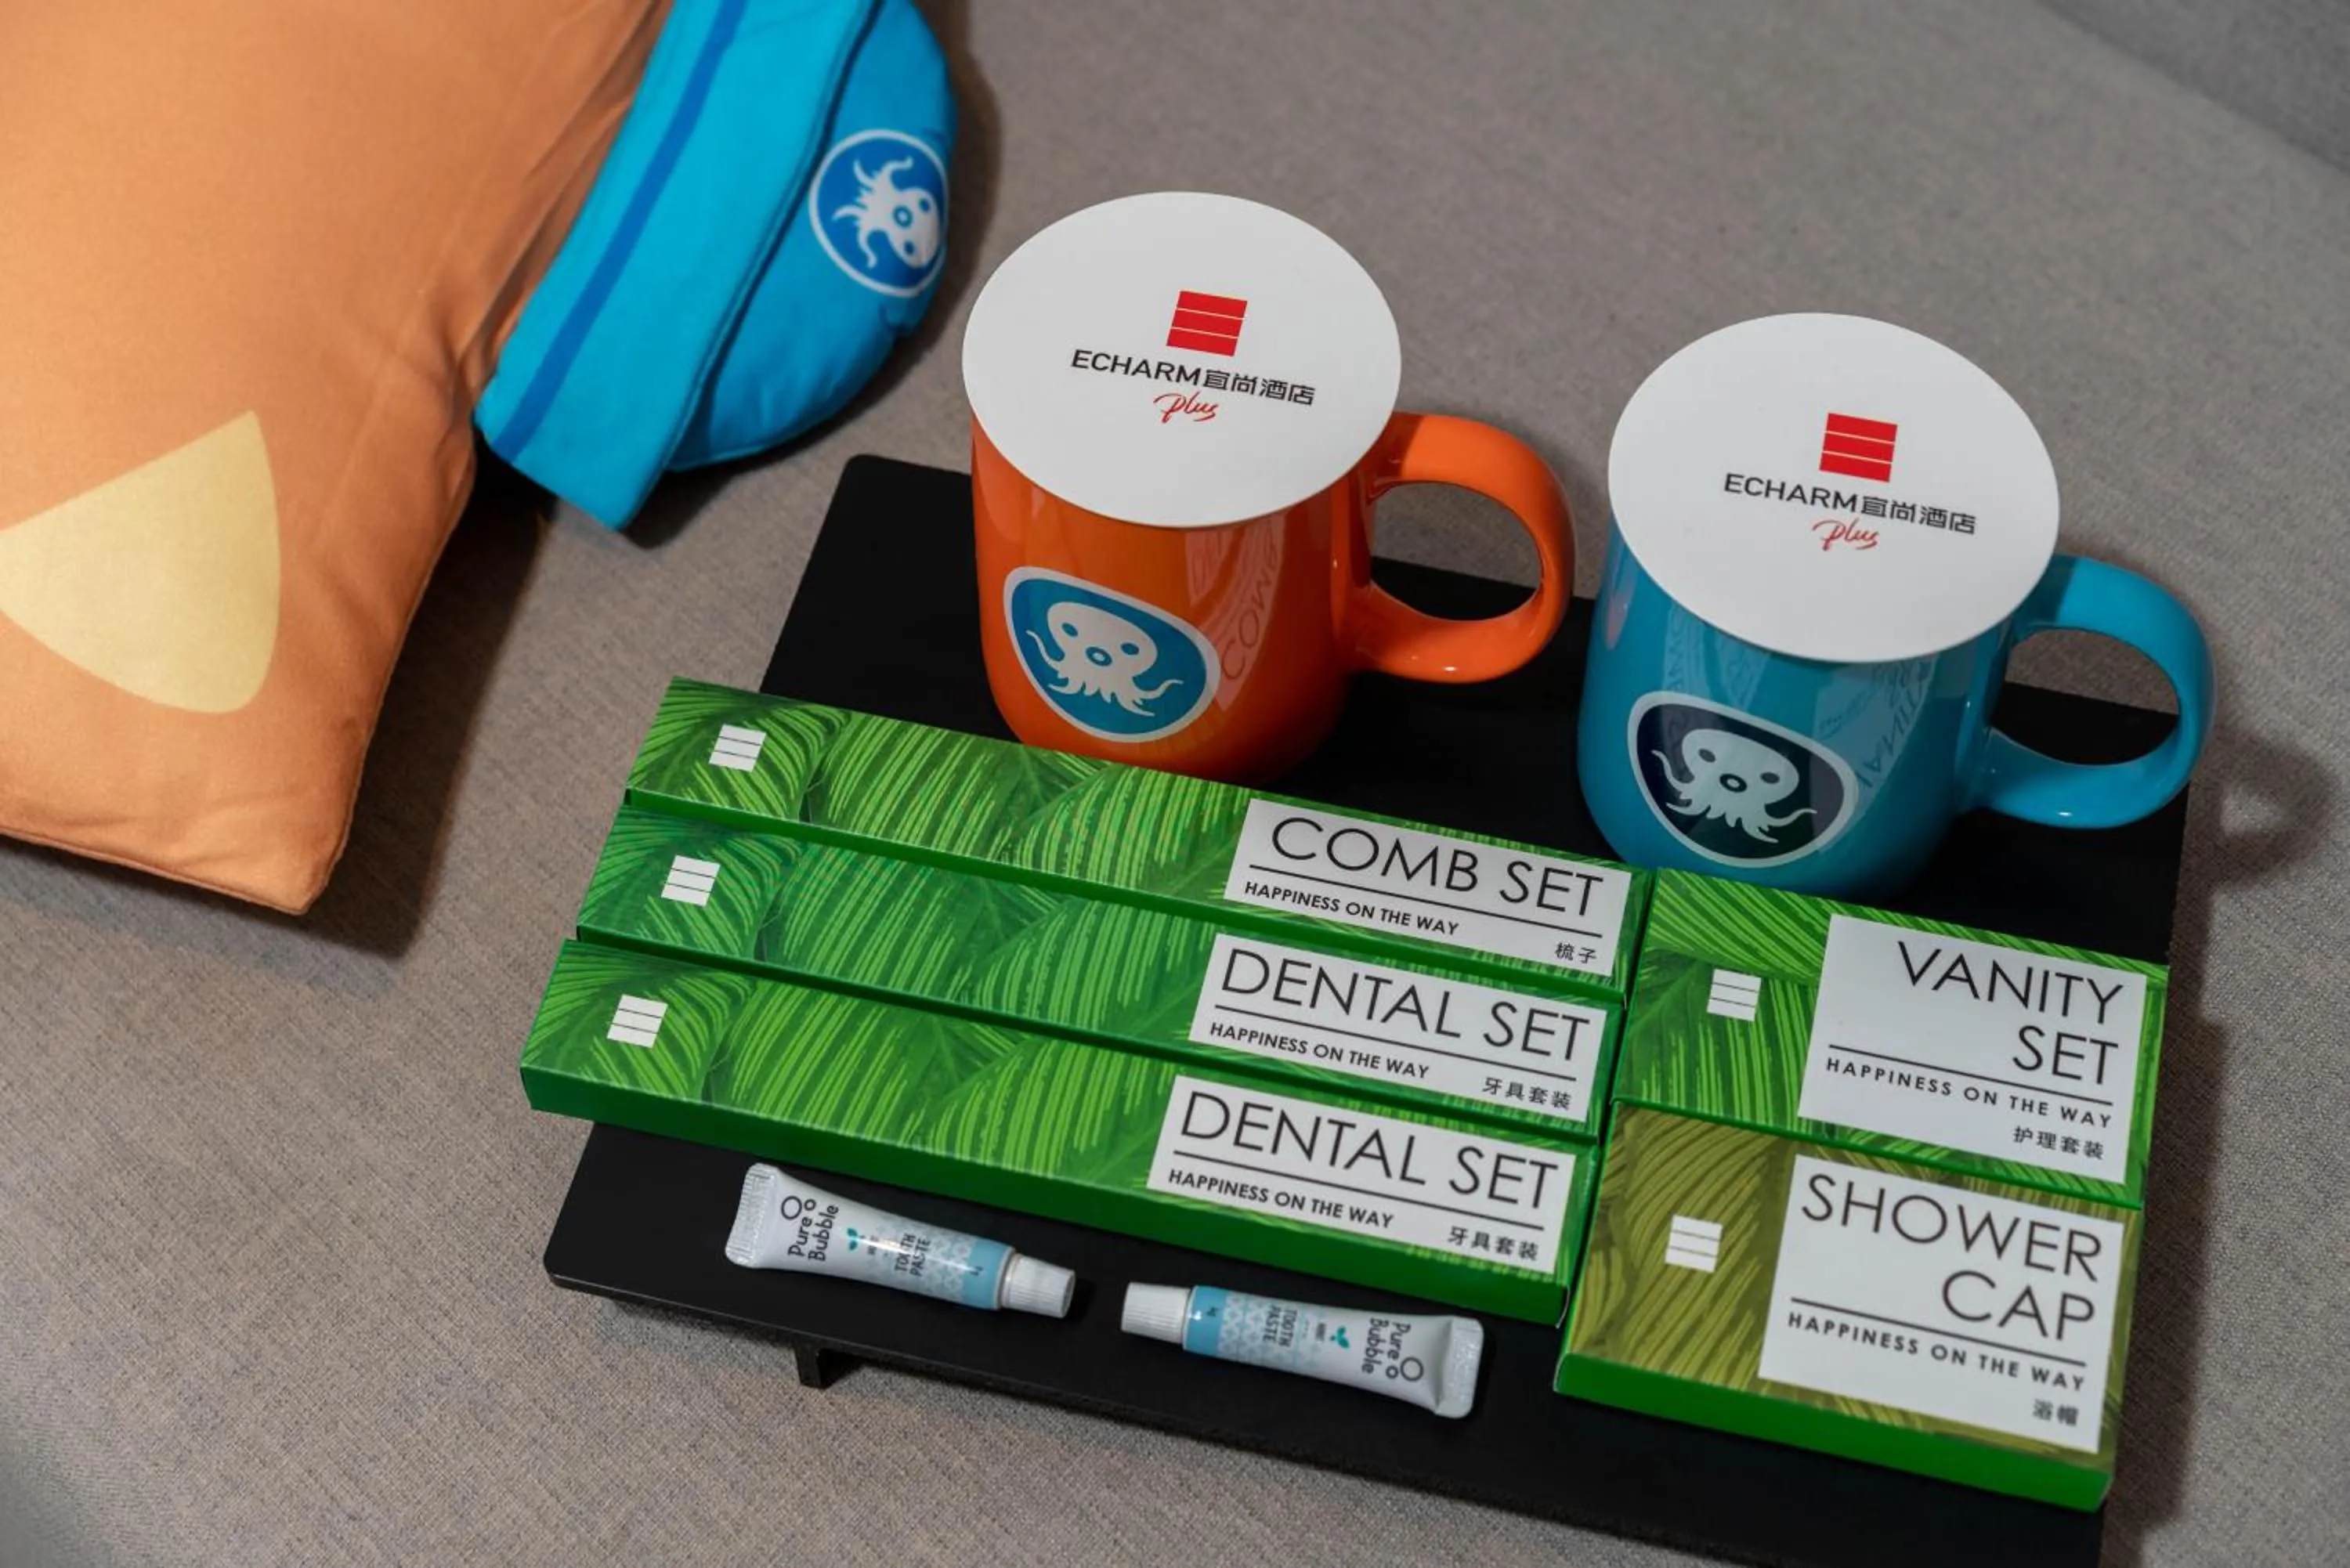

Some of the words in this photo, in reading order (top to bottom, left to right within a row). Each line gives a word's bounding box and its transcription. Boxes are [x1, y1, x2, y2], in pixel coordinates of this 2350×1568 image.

[1071, 349, 1202, 386] ECHARM
[1723, 472, 1857, 513] ECHARM
[1271, 817, 1479, 892] COMB
[1499, 860, 1604, 917] SET
[1244, 880, 1340, 912] HAPPINESS
[1345, 901, 1376, 920] ON
[1380, 908, 1412, 927] THE
[1416, 915, 1459, 936] WAY
[1554, 941, 1598, 964] 梳子
[1221, 948, 1462, 1039] DENTAL
[1483, 1000, 1590, 1061] SET
[1897, 940, 2124, 1024] VANITY
[1209, 1021, 1308, 1054] HAPPINESS
[1313, 1042, 1344, 1062] ON
[1349, 1050, 1380, 1070] THE
[1386, 1058, 1430, 1079] WAY
[2012, 1024, 2119, 1086] SET
[1482, 1076, 1572, 1111] 牙具套装
[1826, 1057, 1954, 1097] HAPPINESS
[1963, 1087, 1998, 1106] ON
[2008, 1096, 2049, 1117] THE
[2059, 1105, 2113, 1129] WAY
[1180, 1090, 1426, 1186] DENTAL
[1448, 1145, 1559, 1209] SET
[2012, 1125, 2105, 1161] 护理套装
[1167, 1168, 1270, 1204] HAPPINESS
[1274, 1190, 1307, 1212] ON
[1311, 1198, 1343, 1219] THE
[1347, 1205, 1394, 1230] WAY
[1801, 1173, 2102, 1283] SHOWER
[786, 1216, 813, 1259] Pure
[808, 1204, 840, 1263] Bubble
[1447, 1225, 1540, 1262] 牙具套装
[1261, 1303, 1282, 1345] PASTE
[1279, 1308, 1299, 1349] TOOTH
[1941, 1269, 2095, 1342] CAP
[1361, 1317, 1390, 1375] Bubble
[1386, 1320, 1412, 1361] Pure
[1788, 1311, 1920, 1355] HAPPINESS
[1930, 1344, 1968, 1367] ON
[1978, 1353, 2020, 1378] THE
[2030, 1364, 2085, 1392] WAY
